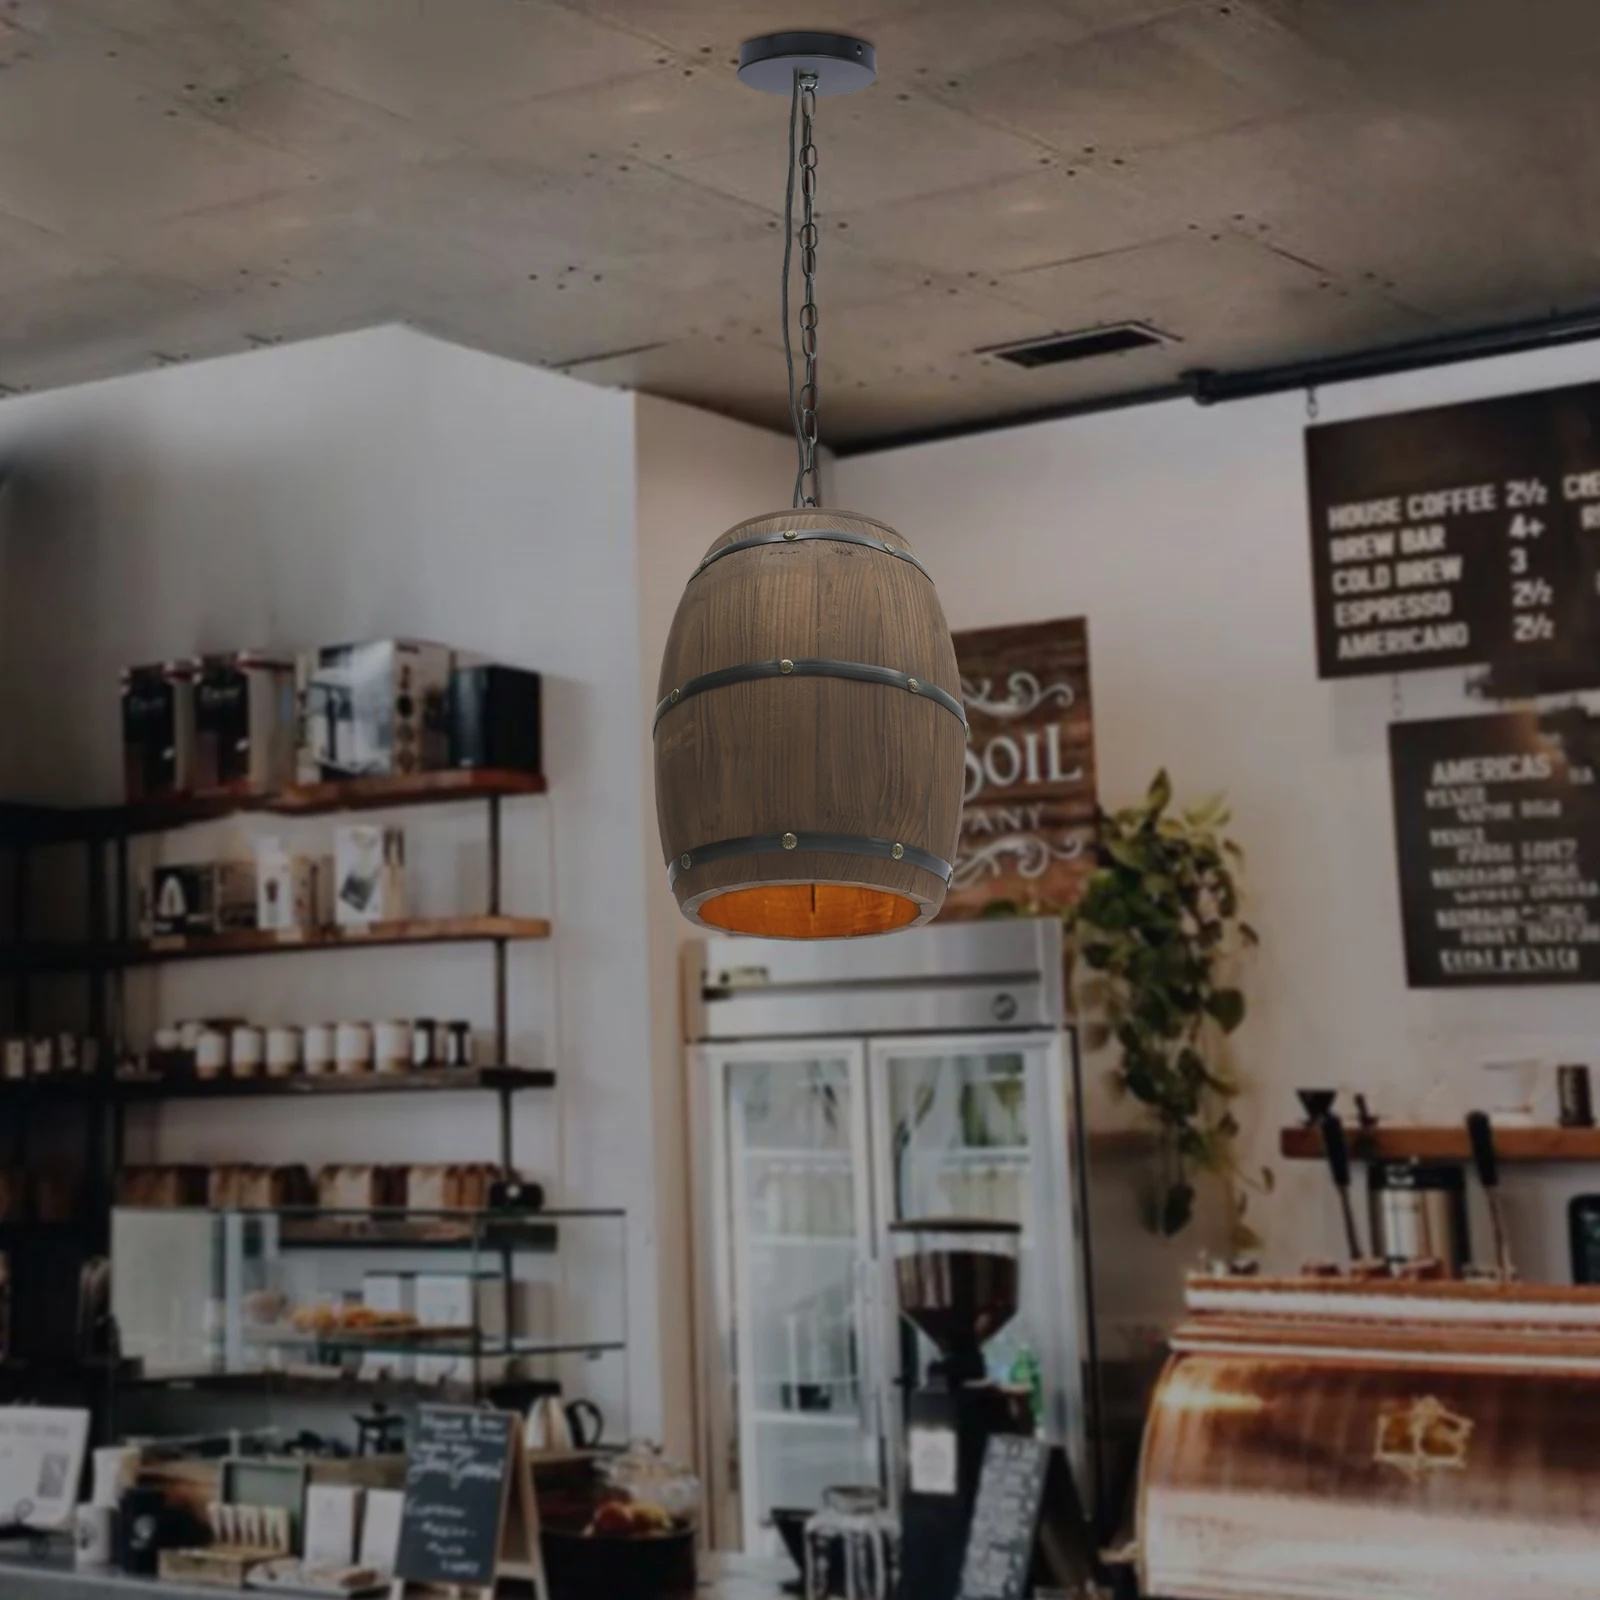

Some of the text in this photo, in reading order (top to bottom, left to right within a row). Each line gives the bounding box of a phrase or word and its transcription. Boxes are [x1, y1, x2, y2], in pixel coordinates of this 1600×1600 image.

[1327, 497, 1401, 531] HOUSE
[1407, 484, 1497, 520] COFFEE
[1330, 513, 1546, 564] BREW BAR 4+
[1332, 548, 1528, 595] COLD BREW 3
[1334, 591, 1453, 628] ESPRESSO
[1338, 622, 1469, 660] AMERICANO
[1432, 753, 1551, 787] AMERICAS
[966, 803, 1043, 833] ANY
